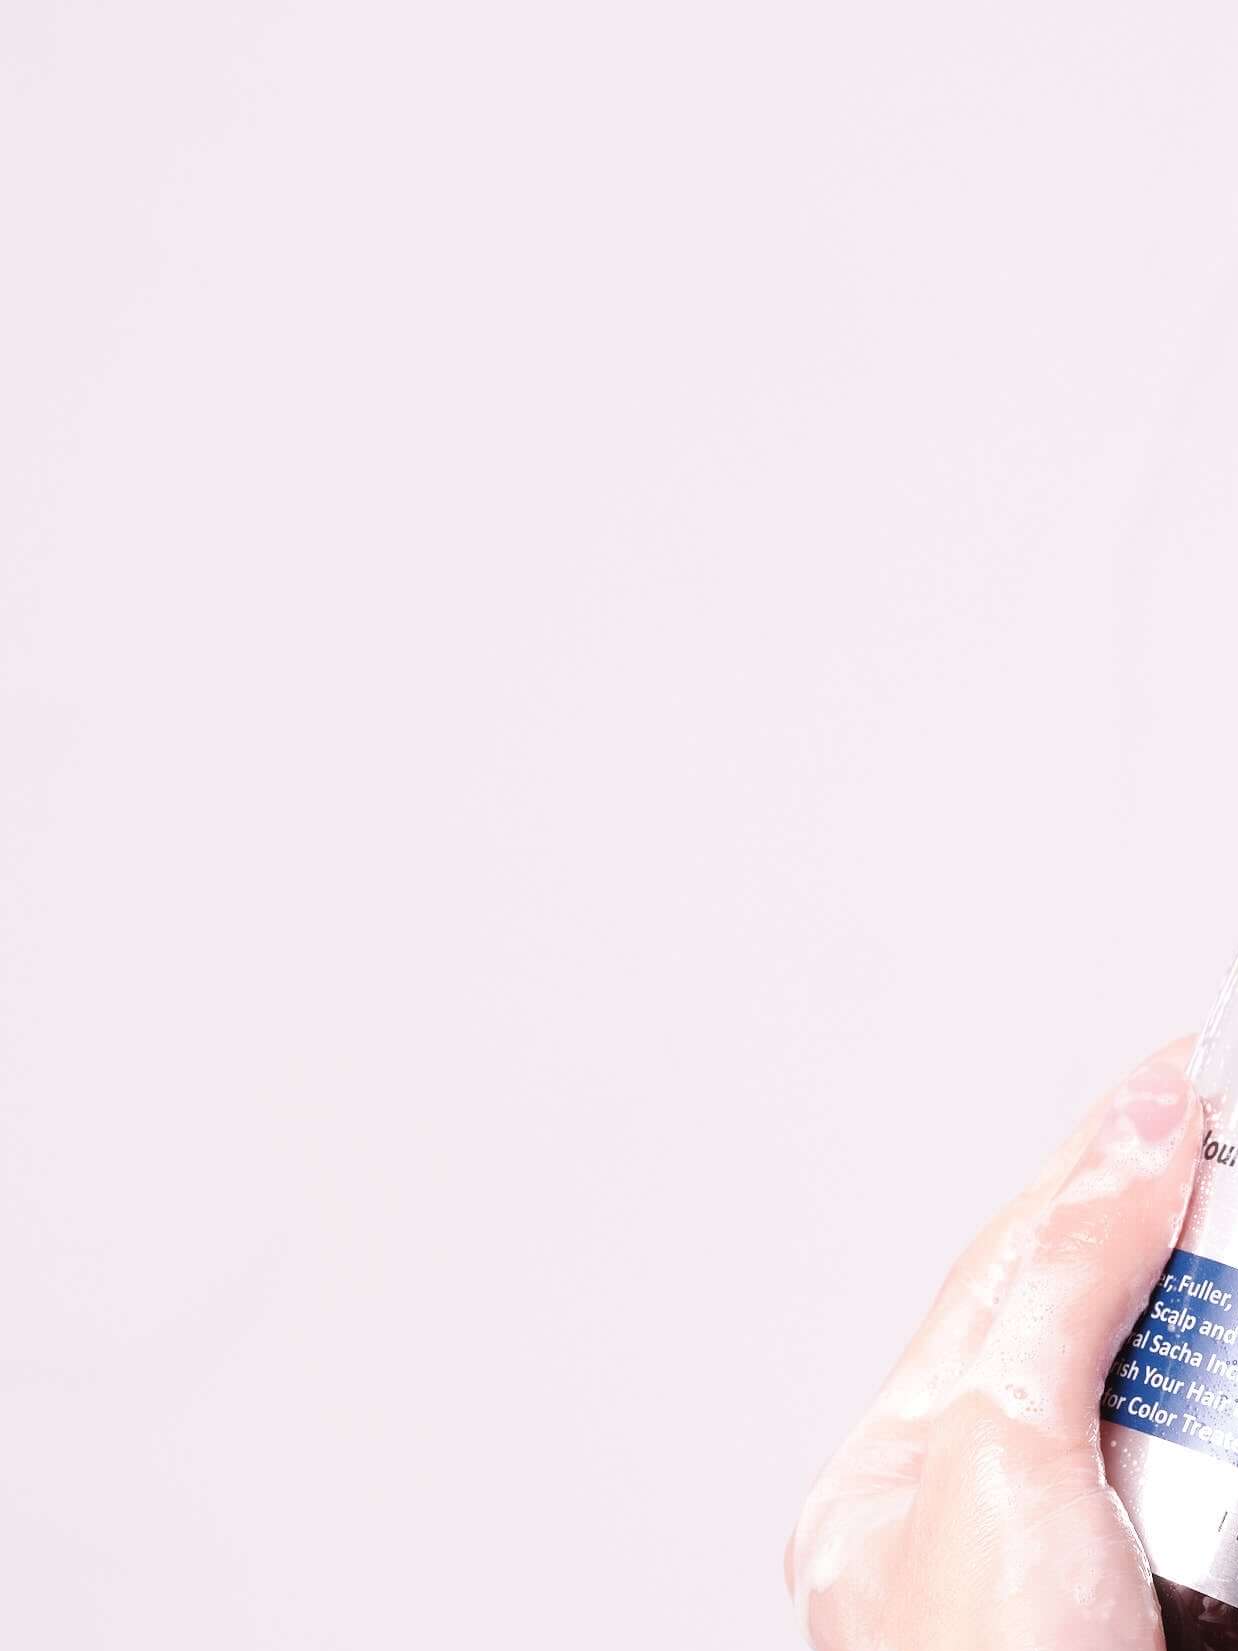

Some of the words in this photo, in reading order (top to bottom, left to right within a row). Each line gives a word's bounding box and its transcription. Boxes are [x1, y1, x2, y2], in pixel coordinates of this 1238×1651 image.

[1178, 1275, 1234, 1312] Fuller,
[1150, 1301, 1197, 1334] Scalp
[1149, 1334, 1204, 1368] Sacha
[1143, 1364, 1185, 1395] Your
[1186, 1380, 1231, 1410] Hair
[1127, 1396, 1178, 1428] Color
